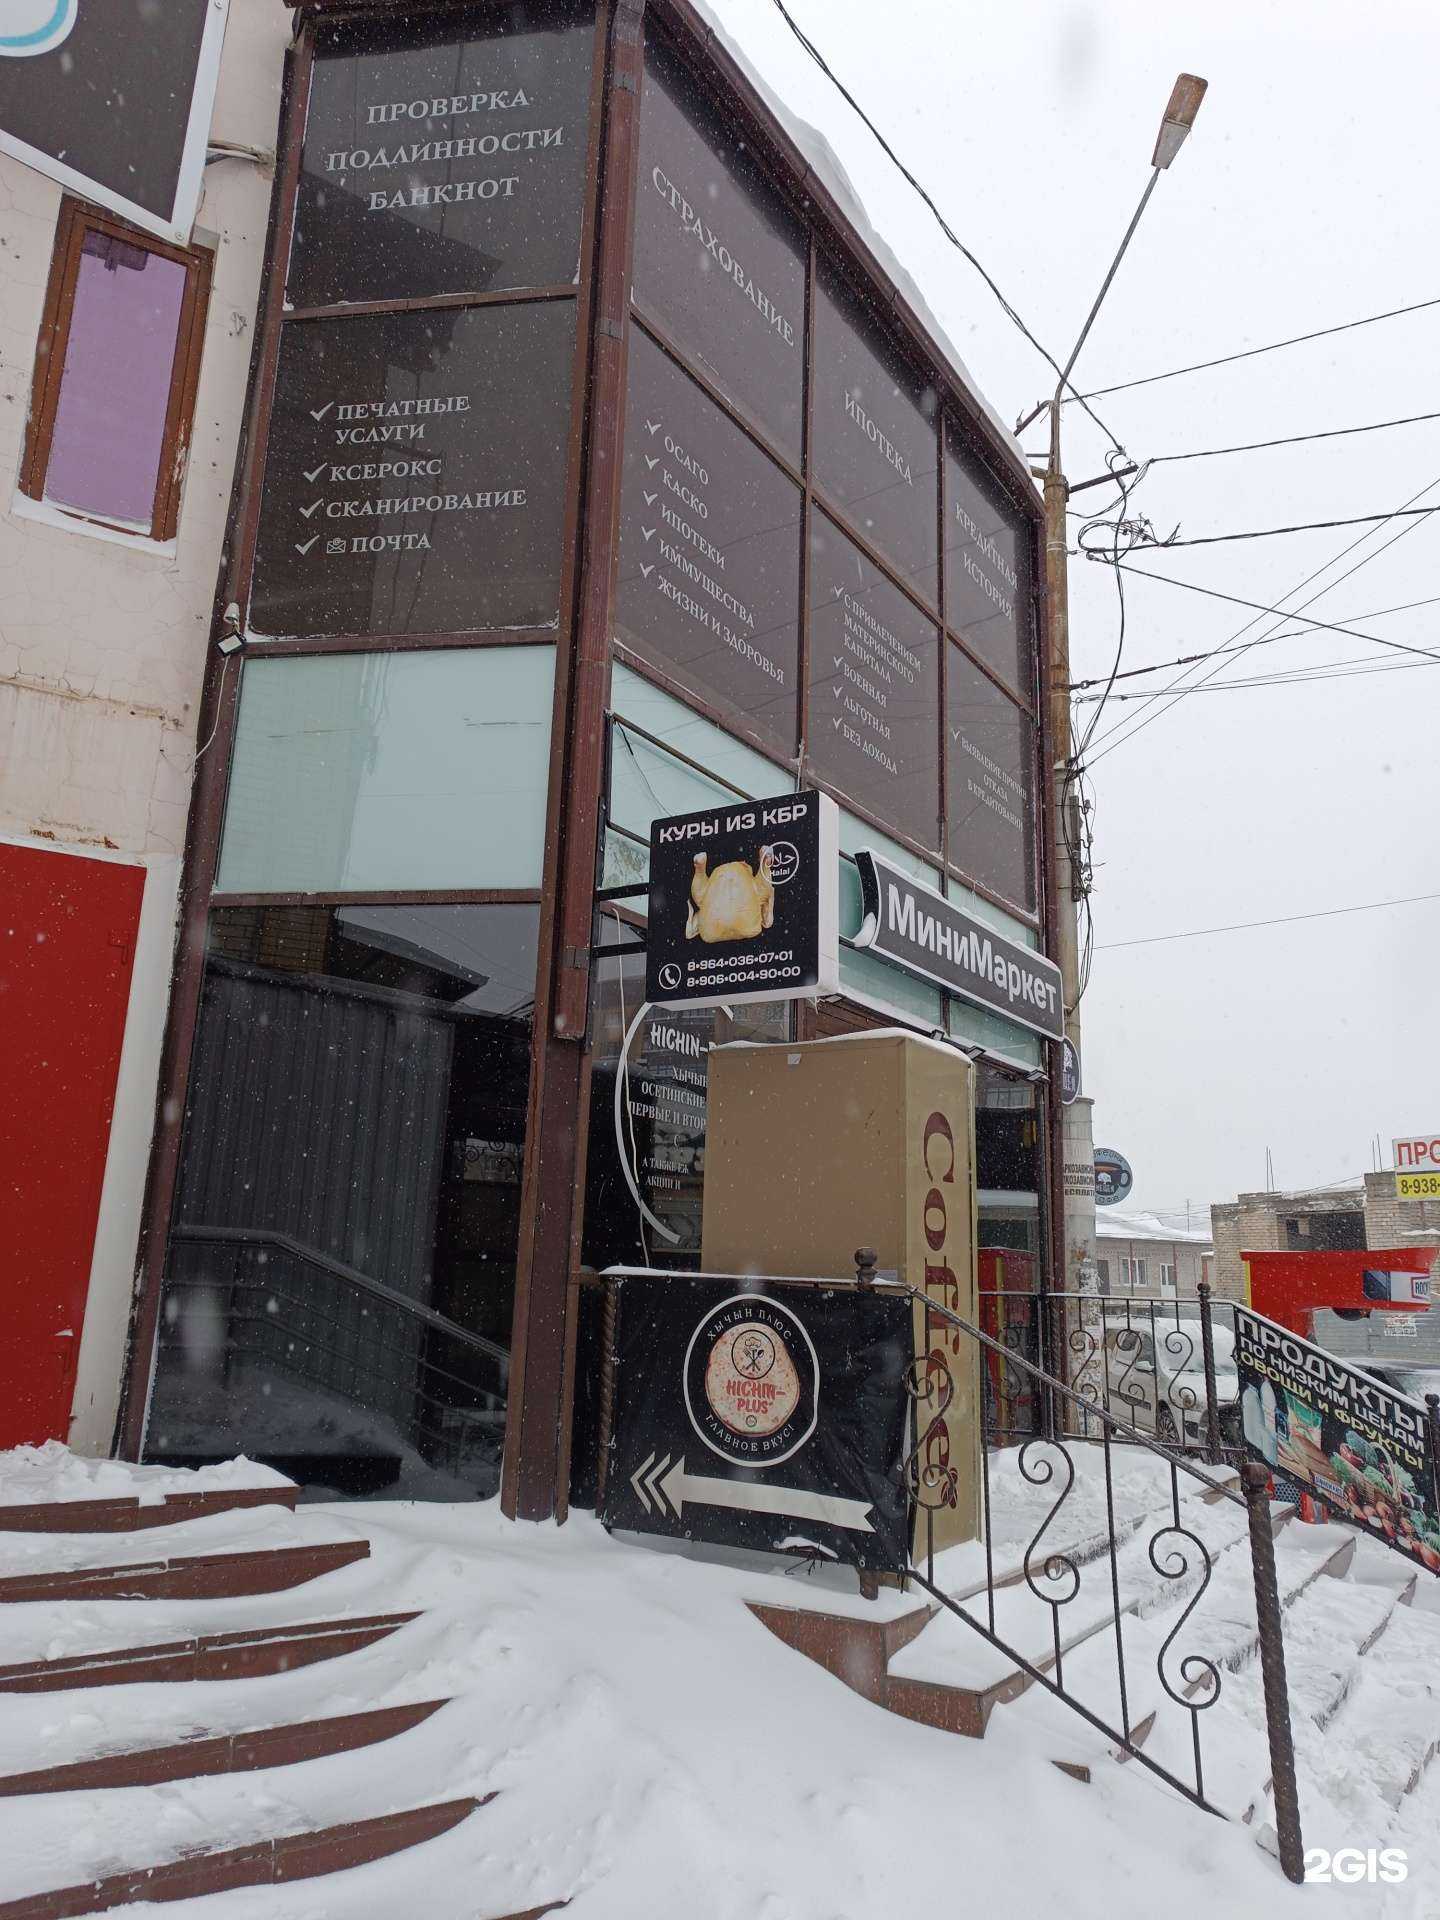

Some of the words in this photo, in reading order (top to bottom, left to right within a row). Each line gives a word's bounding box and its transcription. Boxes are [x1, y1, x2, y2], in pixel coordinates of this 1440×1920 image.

[366, 88, 530, 124] ПРОВЕРКА
[326, 127, 564, 171] ПОДЛИННОСТИ
[368, 176, 520, 211] БАНКНОТ
[652, 167, 794, 347] СТРАХОВАНИЕ
[335, 396, 471, 420] ПЕЧАТНЫЕ
[335, 423, 425, 445] УСЛУГИ
[844, 391, 913, 487] ИПОТЕКА
[328, 459, 442, 481] КСЕРОКС
[664, 436, 709, 485] ОСАГО
[325, 489, 527, 518] СКАНИРОВАНИЕ
[663, 468, 708, 519] КАСКО
[350, 532, 432, 553] ПОЧТА
[661, 504, 726, 570] ИПОТЕКИ
[955, 502, 1019, 592] КРЕДИТНАЯ
[659, 538, 755, 629] ИММУЩЕСТВА
[963, 551, 1013, 621] ИСТОРИЯ
[657, 575, 709, 626] ЖИЗНИ
[711, 616, 721, 636] И
[723, 625, 785, 685] ЗДОРОВЬЯ
[844, 594, 851, 609] С
[852, 600, 921, 672] ПРИВЛЕЧЕНИЕМ
[844, 612, 914, 683] МАТЕРИНСКОГО
[844, 634, 892, 684] КАПИТАЛА
[844, 663, 887, 709] ВОЕННАЯ
[844, 695, 890, 739] ЛЬГОТНАЯ
[843, 723, 860, 748] БЕЗ
[862, 739, 897, 775] ДОХОДА
[659, 819, 719, 844] КУРЫ
[726, 812, 756, 832] ИЗ
[762, 804, 807, 826] КБР
[888, 883, 1057, 1014] МиниМаркет
[641, 1081, 706, 1109] ОСЕТИНСКИЕ
[707, 1308, 753, 1341] ХЫЧЫН
[759, 1309, 792, 1341] ПЛЮС
[1238, 1312, 1425, 1439] ПРОДУКТЫ
[1241, 1336, 1266, 1359] ПО
[1270, 1353, 1349, 1410] НИЗКИМ
[1355, 1402, 1425, 1455] ЦЕНАМ
[705, 1414, 758, 1452] ГЛАВНОЕ
[1241, 1351, 1312, 1403] ОВОЩИ
[1334, 1409, 1424, 1471] ФРУКТЫ
